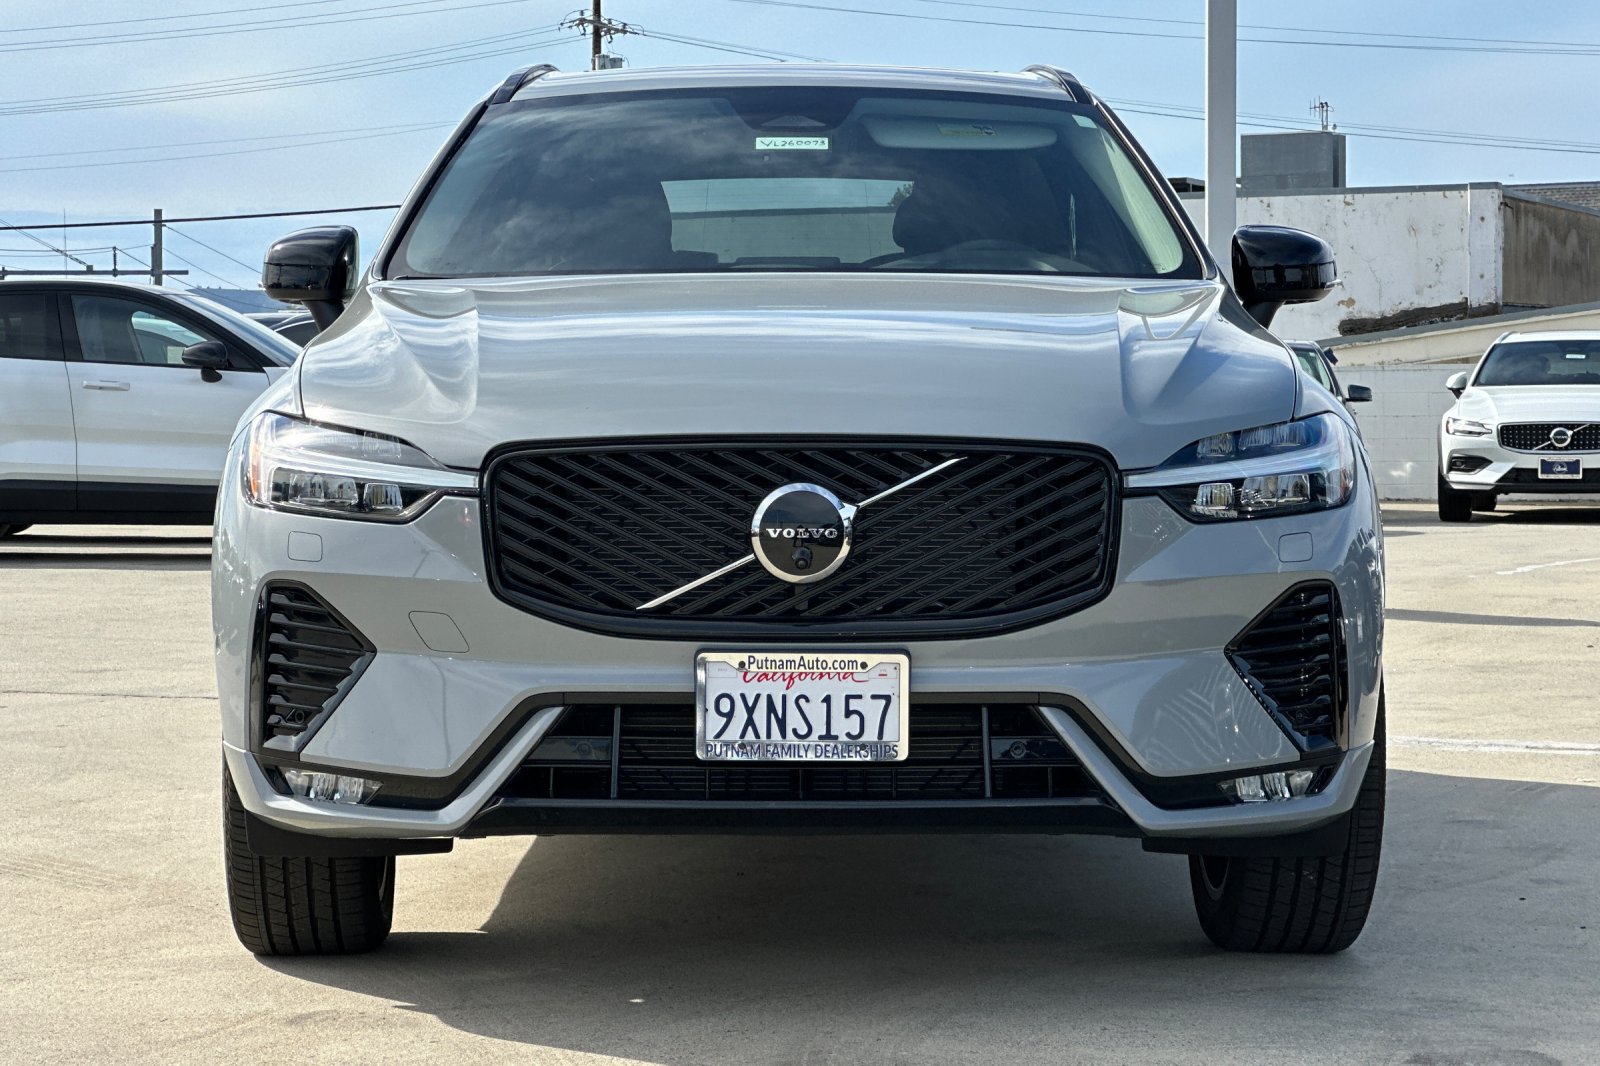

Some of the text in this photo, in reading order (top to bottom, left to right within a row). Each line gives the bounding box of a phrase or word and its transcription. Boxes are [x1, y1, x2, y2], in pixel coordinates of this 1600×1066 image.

[766, 528, 838, 538] VOLVO
[747, 655, 859, 671] PutnamAuto.com
[713, 692, 892, 740] 9XNS157
[706, 743, 899, 759] PUTNAM FAMILY DEALERSHIPS
